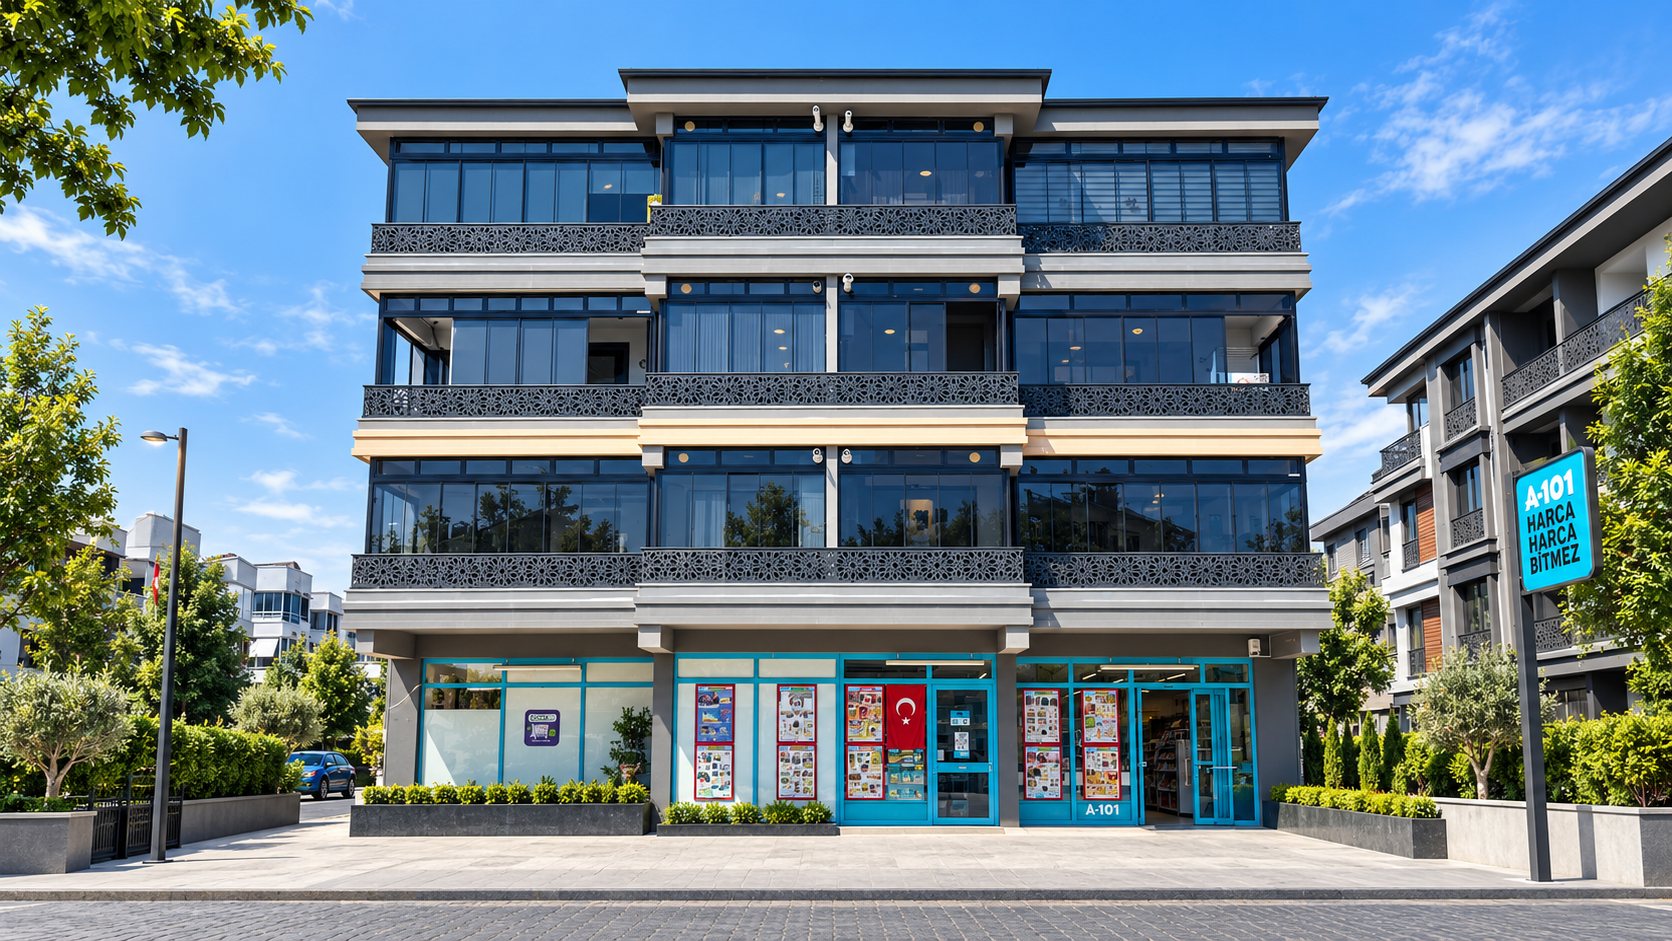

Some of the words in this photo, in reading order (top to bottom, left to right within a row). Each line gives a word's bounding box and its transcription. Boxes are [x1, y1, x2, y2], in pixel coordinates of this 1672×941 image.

[1525, 469, 1574, 511] A-101
[1527, 501, 1576, 533] HARCA
[1529, 523, 1577, 554] HARCA
[1530, 543, 1580, 575] BİTMEZ
[1085, 804, 1119, 815] A-101
